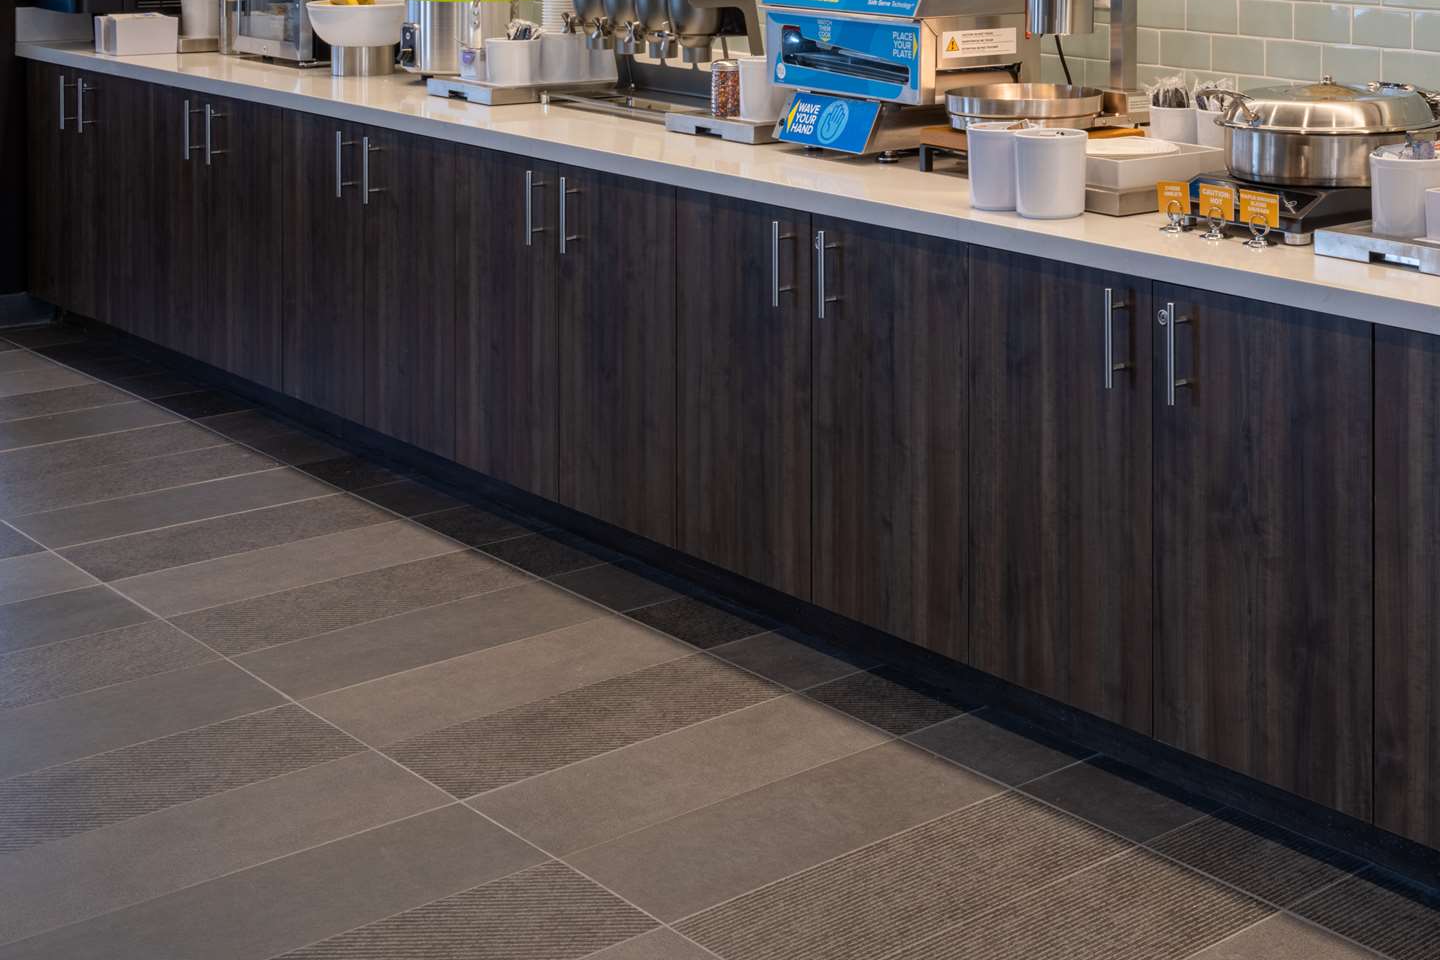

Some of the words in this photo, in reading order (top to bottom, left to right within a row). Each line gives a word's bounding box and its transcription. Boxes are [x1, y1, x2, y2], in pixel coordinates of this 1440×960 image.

[892, 31, 913, 41] PLACE
[893, 40, 912, 50] YOUR
[892, 49, 912, 59] PLATE
[798, 102, 821, 114] WAVE
[795, 113, 817, 125] YOUR
[790, 123, 814, 135] HAND
